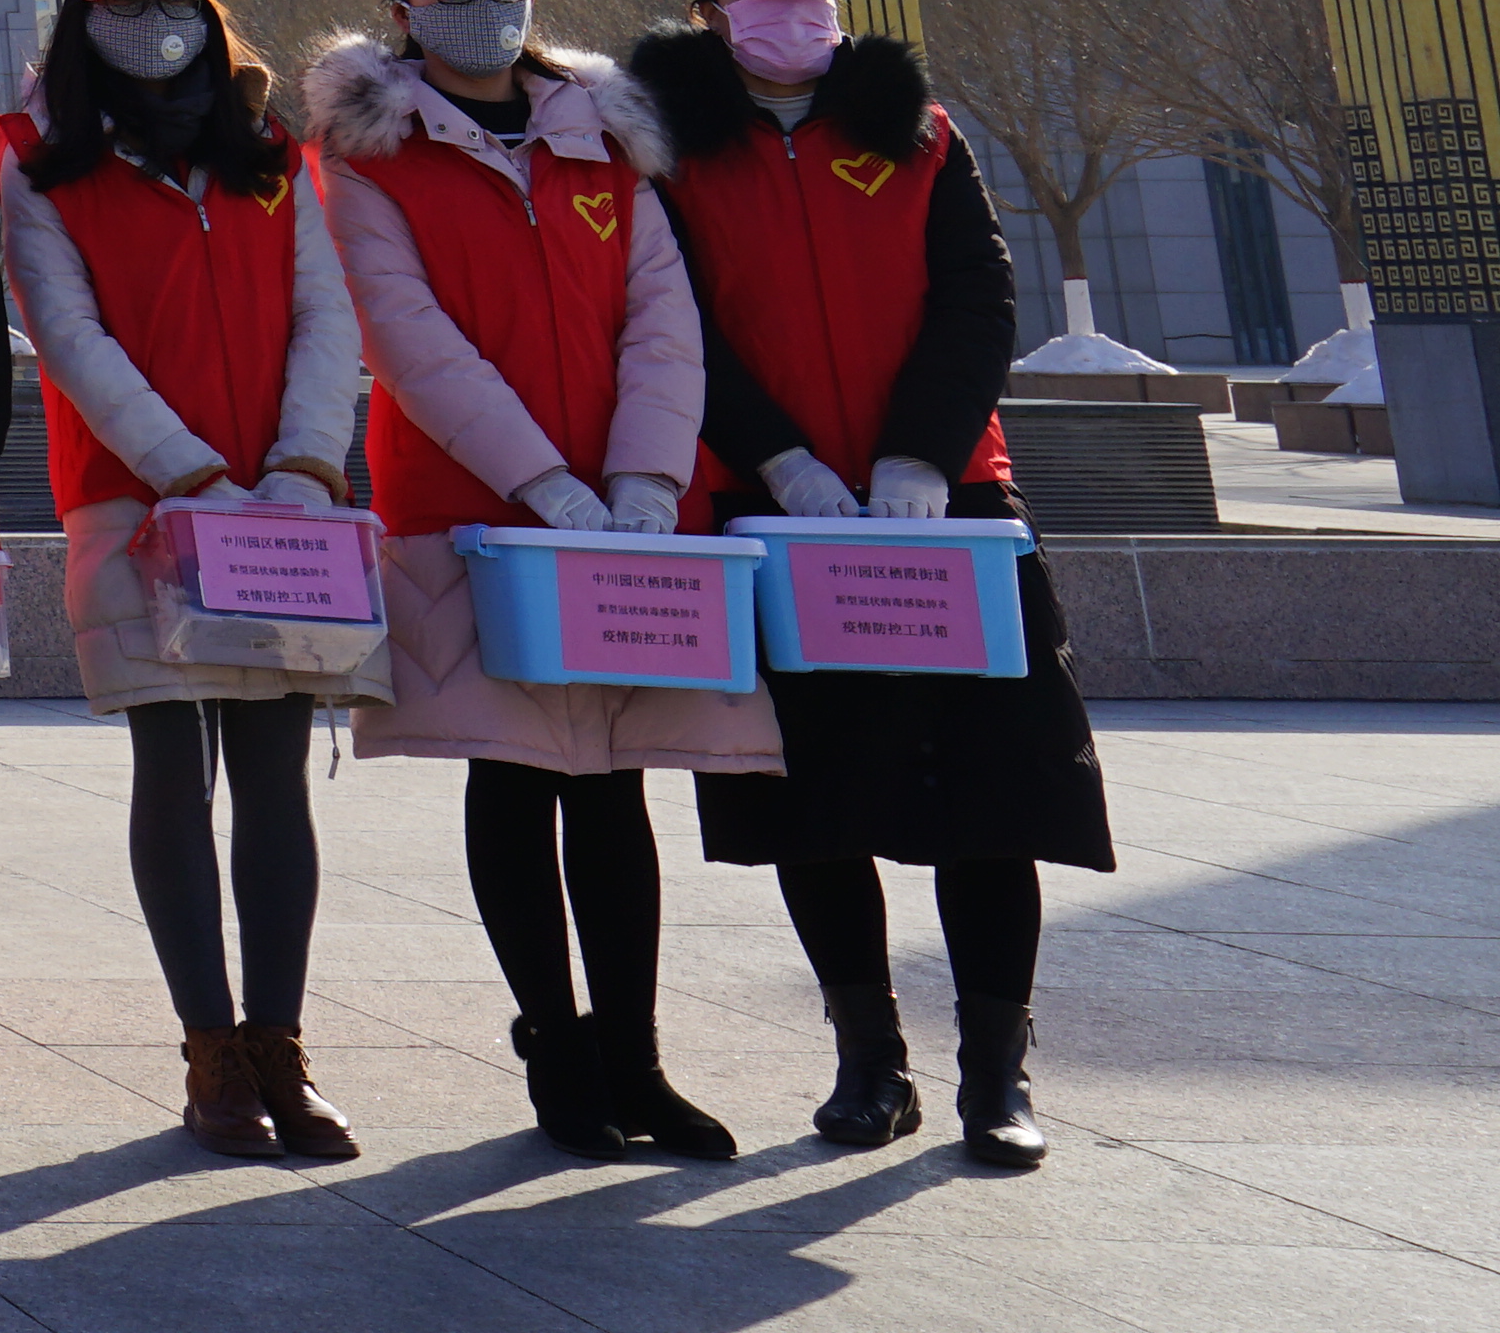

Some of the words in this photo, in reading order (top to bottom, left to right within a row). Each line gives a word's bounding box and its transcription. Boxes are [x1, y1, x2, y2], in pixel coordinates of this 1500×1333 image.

[220, 535, 330, 552] 中川园区栖霞街道
[228, 564, 330, 578] 新型冠状病毒感染肺炎
[827, 564, 949, 582] 中川园区栖霞街道
[592, 572, 701, 592] 中川园区栖霞街道
[236, 589, 332, 605] 疫情防控工具箱
[834, 594, 949, 610] 新型冠状病毒感染肺炎
[597, 603, 700, 619] 新型冠状病毒感染肺炎
[841, 620, 948, 639] 疫情防控工具箱
[602, 629, 698, 648] 疫情防控工具箱
